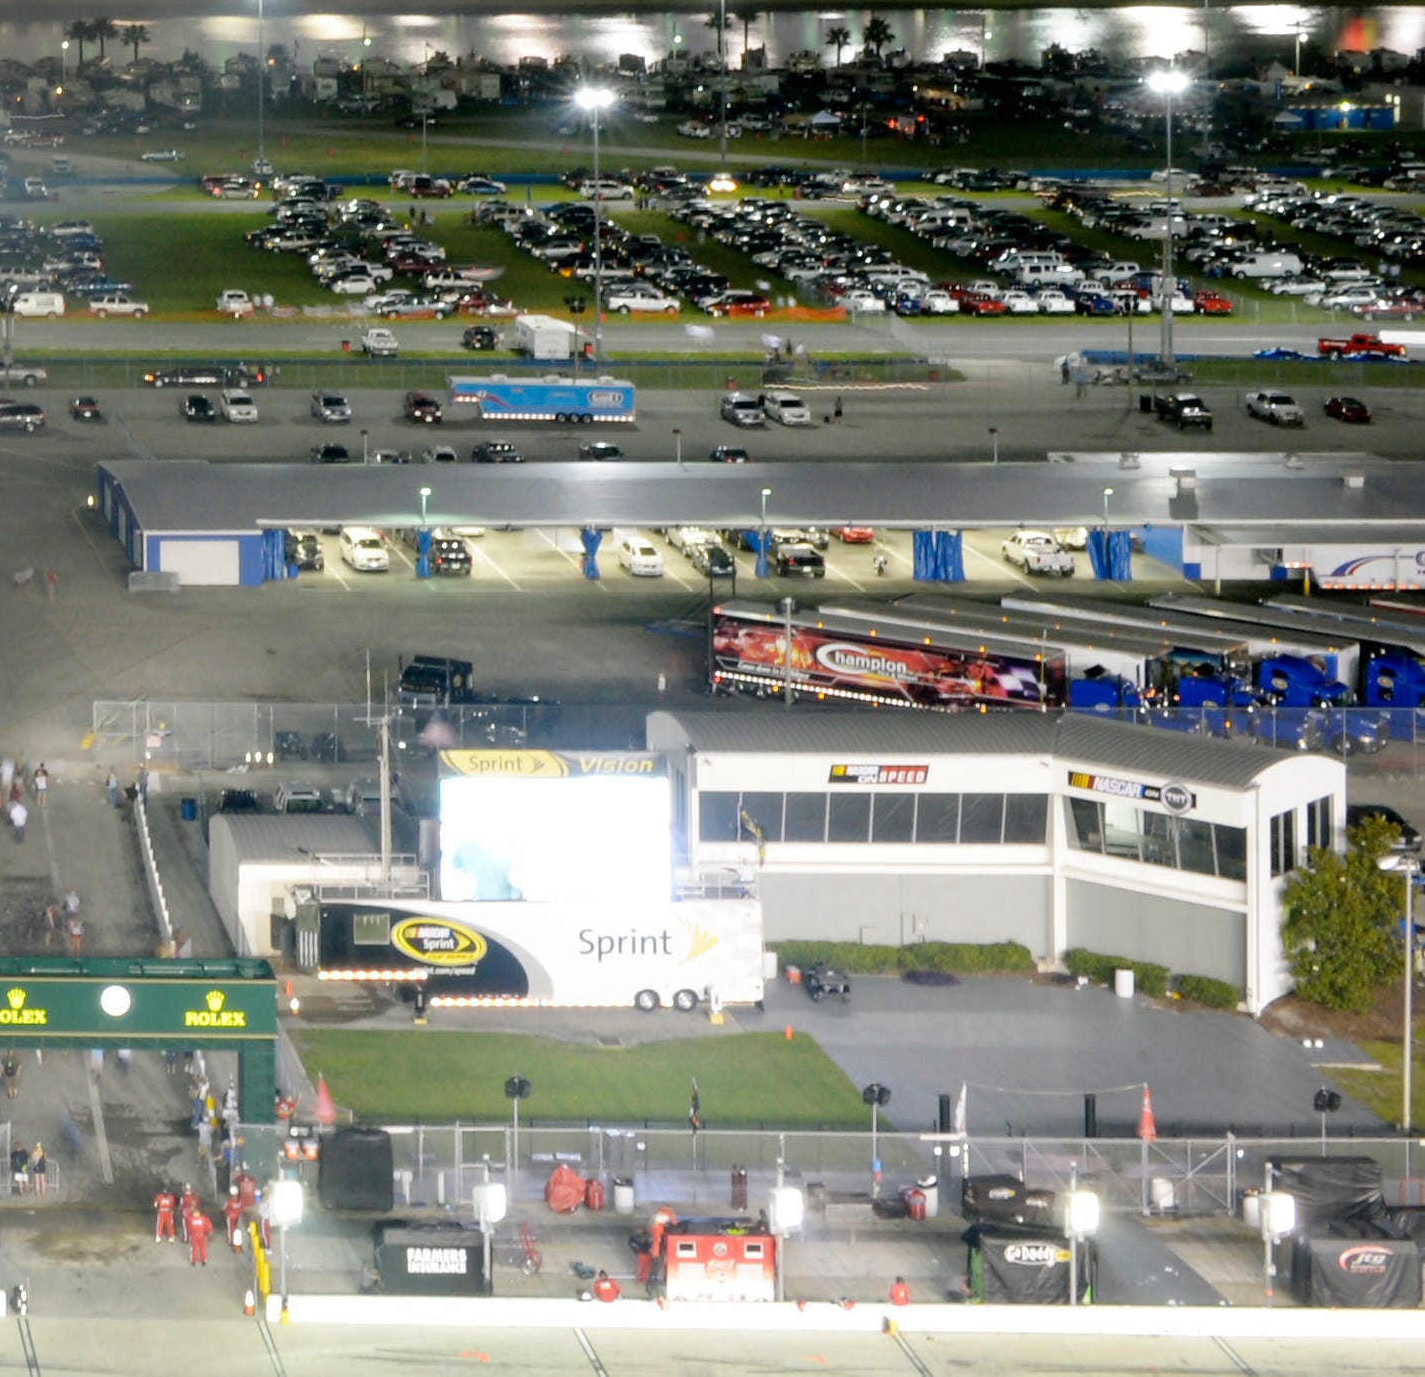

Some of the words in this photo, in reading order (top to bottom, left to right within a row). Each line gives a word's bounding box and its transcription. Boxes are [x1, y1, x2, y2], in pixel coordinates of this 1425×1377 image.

[816, 643, 907, 675] Champion
[468, 755, 524, 773] Sprint
[580, 756, 653, 772] Vision
[879, 770, 926, 783] SPEED
[1093, 776, 1142, 798] NASCAR
[1166, 793, 1186, 804] TNT
[422, 938, 454, 951] Sprint
[579, 928, 673, 962] Sprint
[185, 1011, 246, 1027] ROLEX
[407, 1248, 467, 1262] FARMERS
[408, 1261, 467, 1274] INSURANCE
